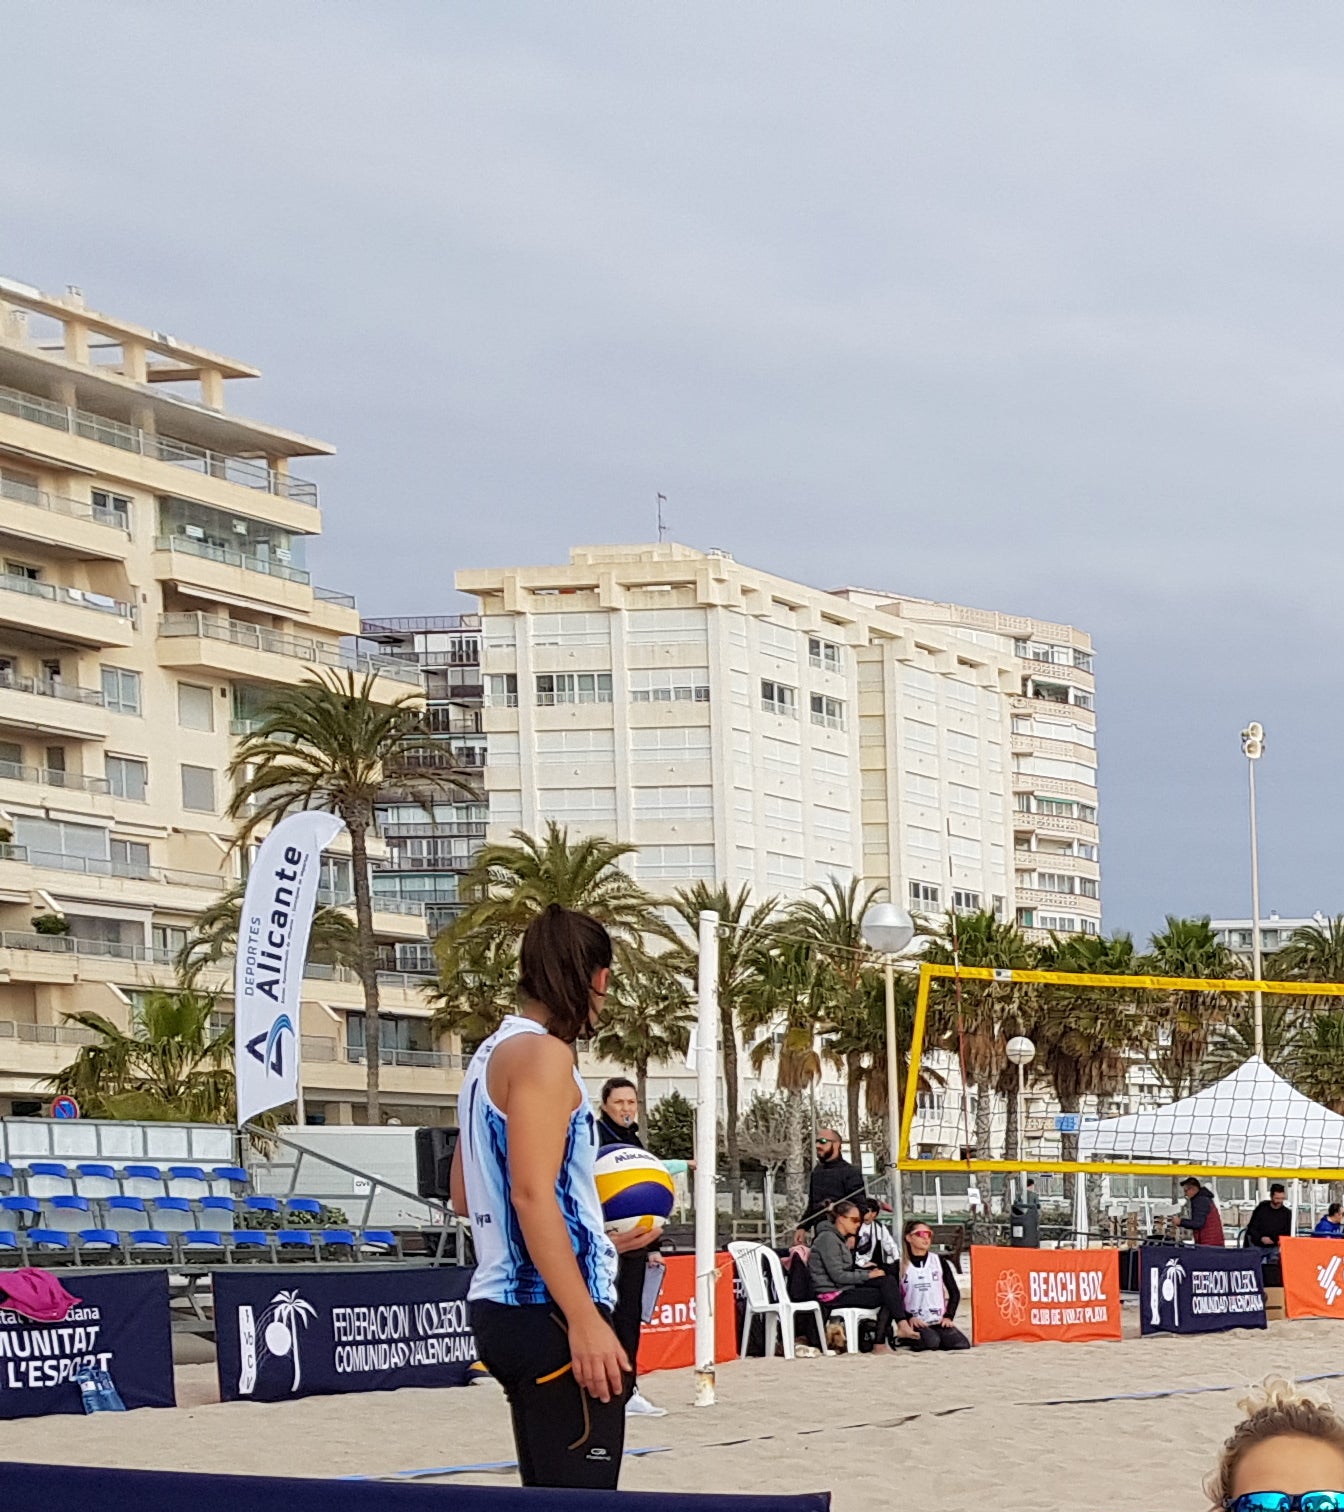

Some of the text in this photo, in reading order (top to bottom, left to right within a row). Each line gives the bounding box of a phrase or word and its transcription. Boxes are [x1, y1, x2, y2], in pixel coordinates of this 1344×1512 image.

[256, 846, 303, 1002] Alicante
[245, 917, 261, 997] DEPORTES
[1029, 1271, 1107, 1303] BEACH BOL
[332, 1304, 410, 1342] FEDERACION
[1051, 1308, 1062, 1326] DE
[335, 1342, 410, 1373] COMUNIDAD
